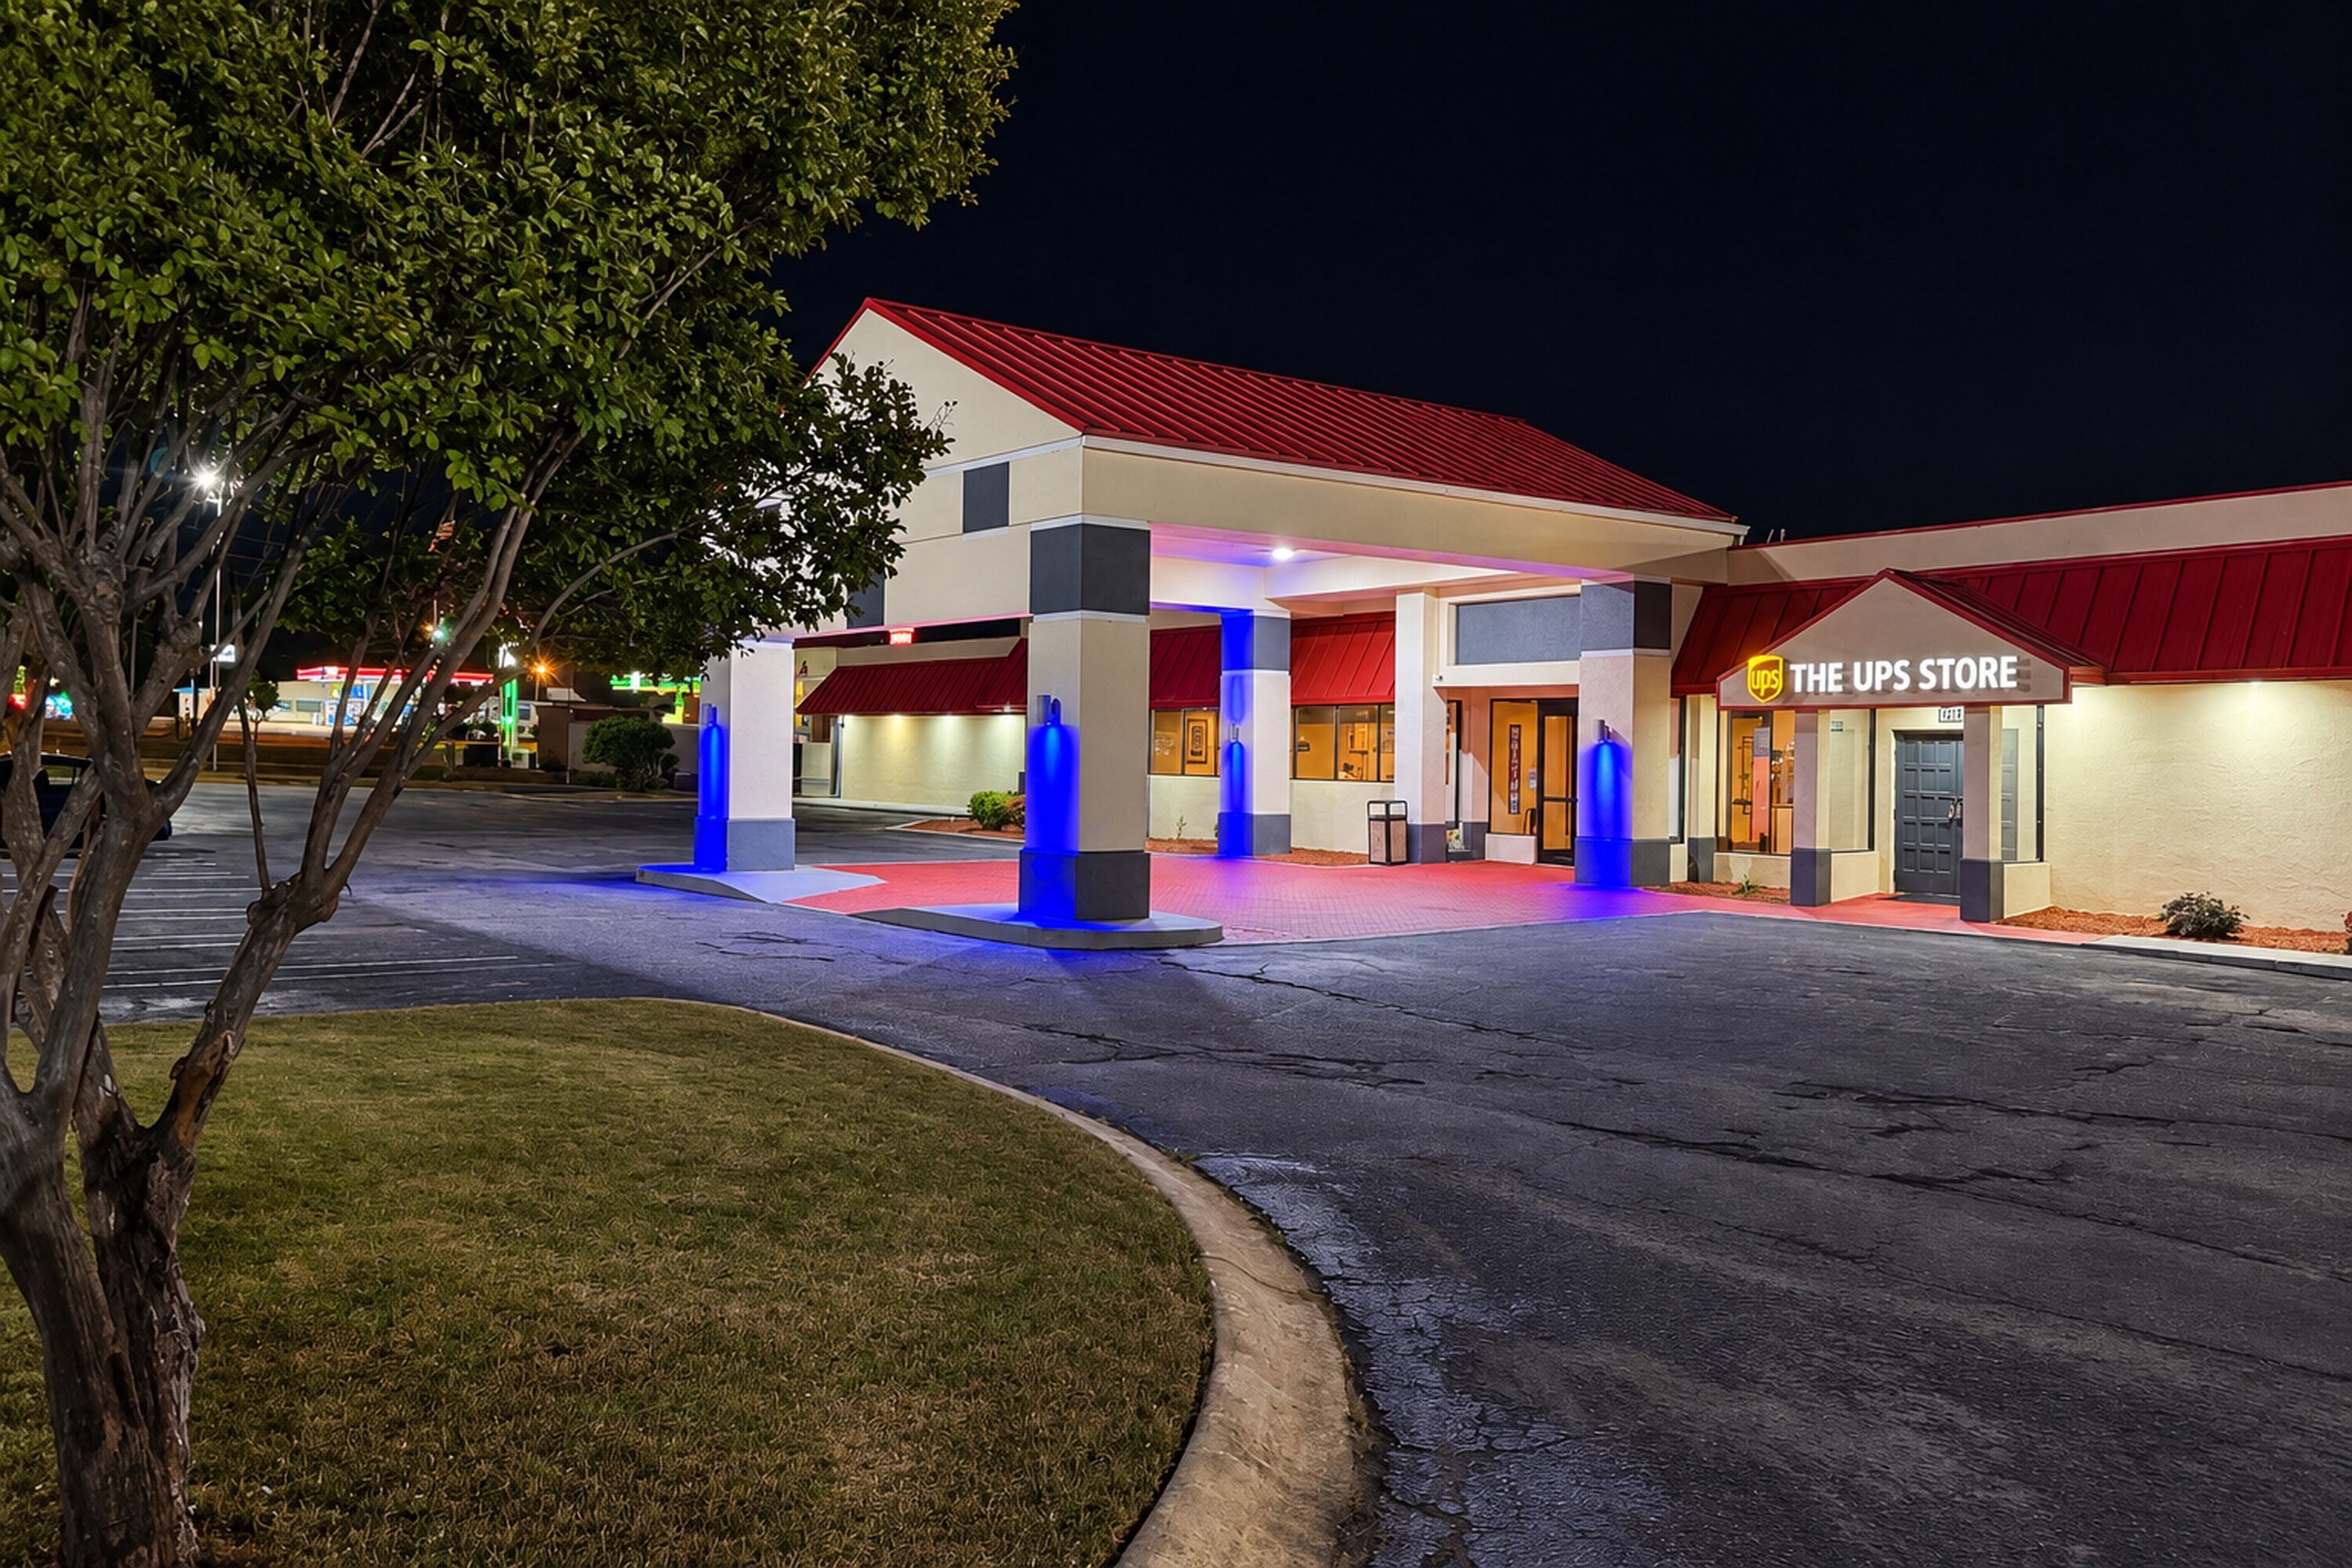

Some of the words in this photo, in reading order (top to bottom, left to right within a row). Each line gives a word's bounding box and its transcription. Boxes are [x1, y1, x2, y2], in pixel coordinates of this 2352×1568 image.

[1751, 669, 1779, 697] ups
[1789, 662, 1844, 693] THE
[1853, 660, 1911, 691] UPS
[1918, 655, 2018, 690] STORE
